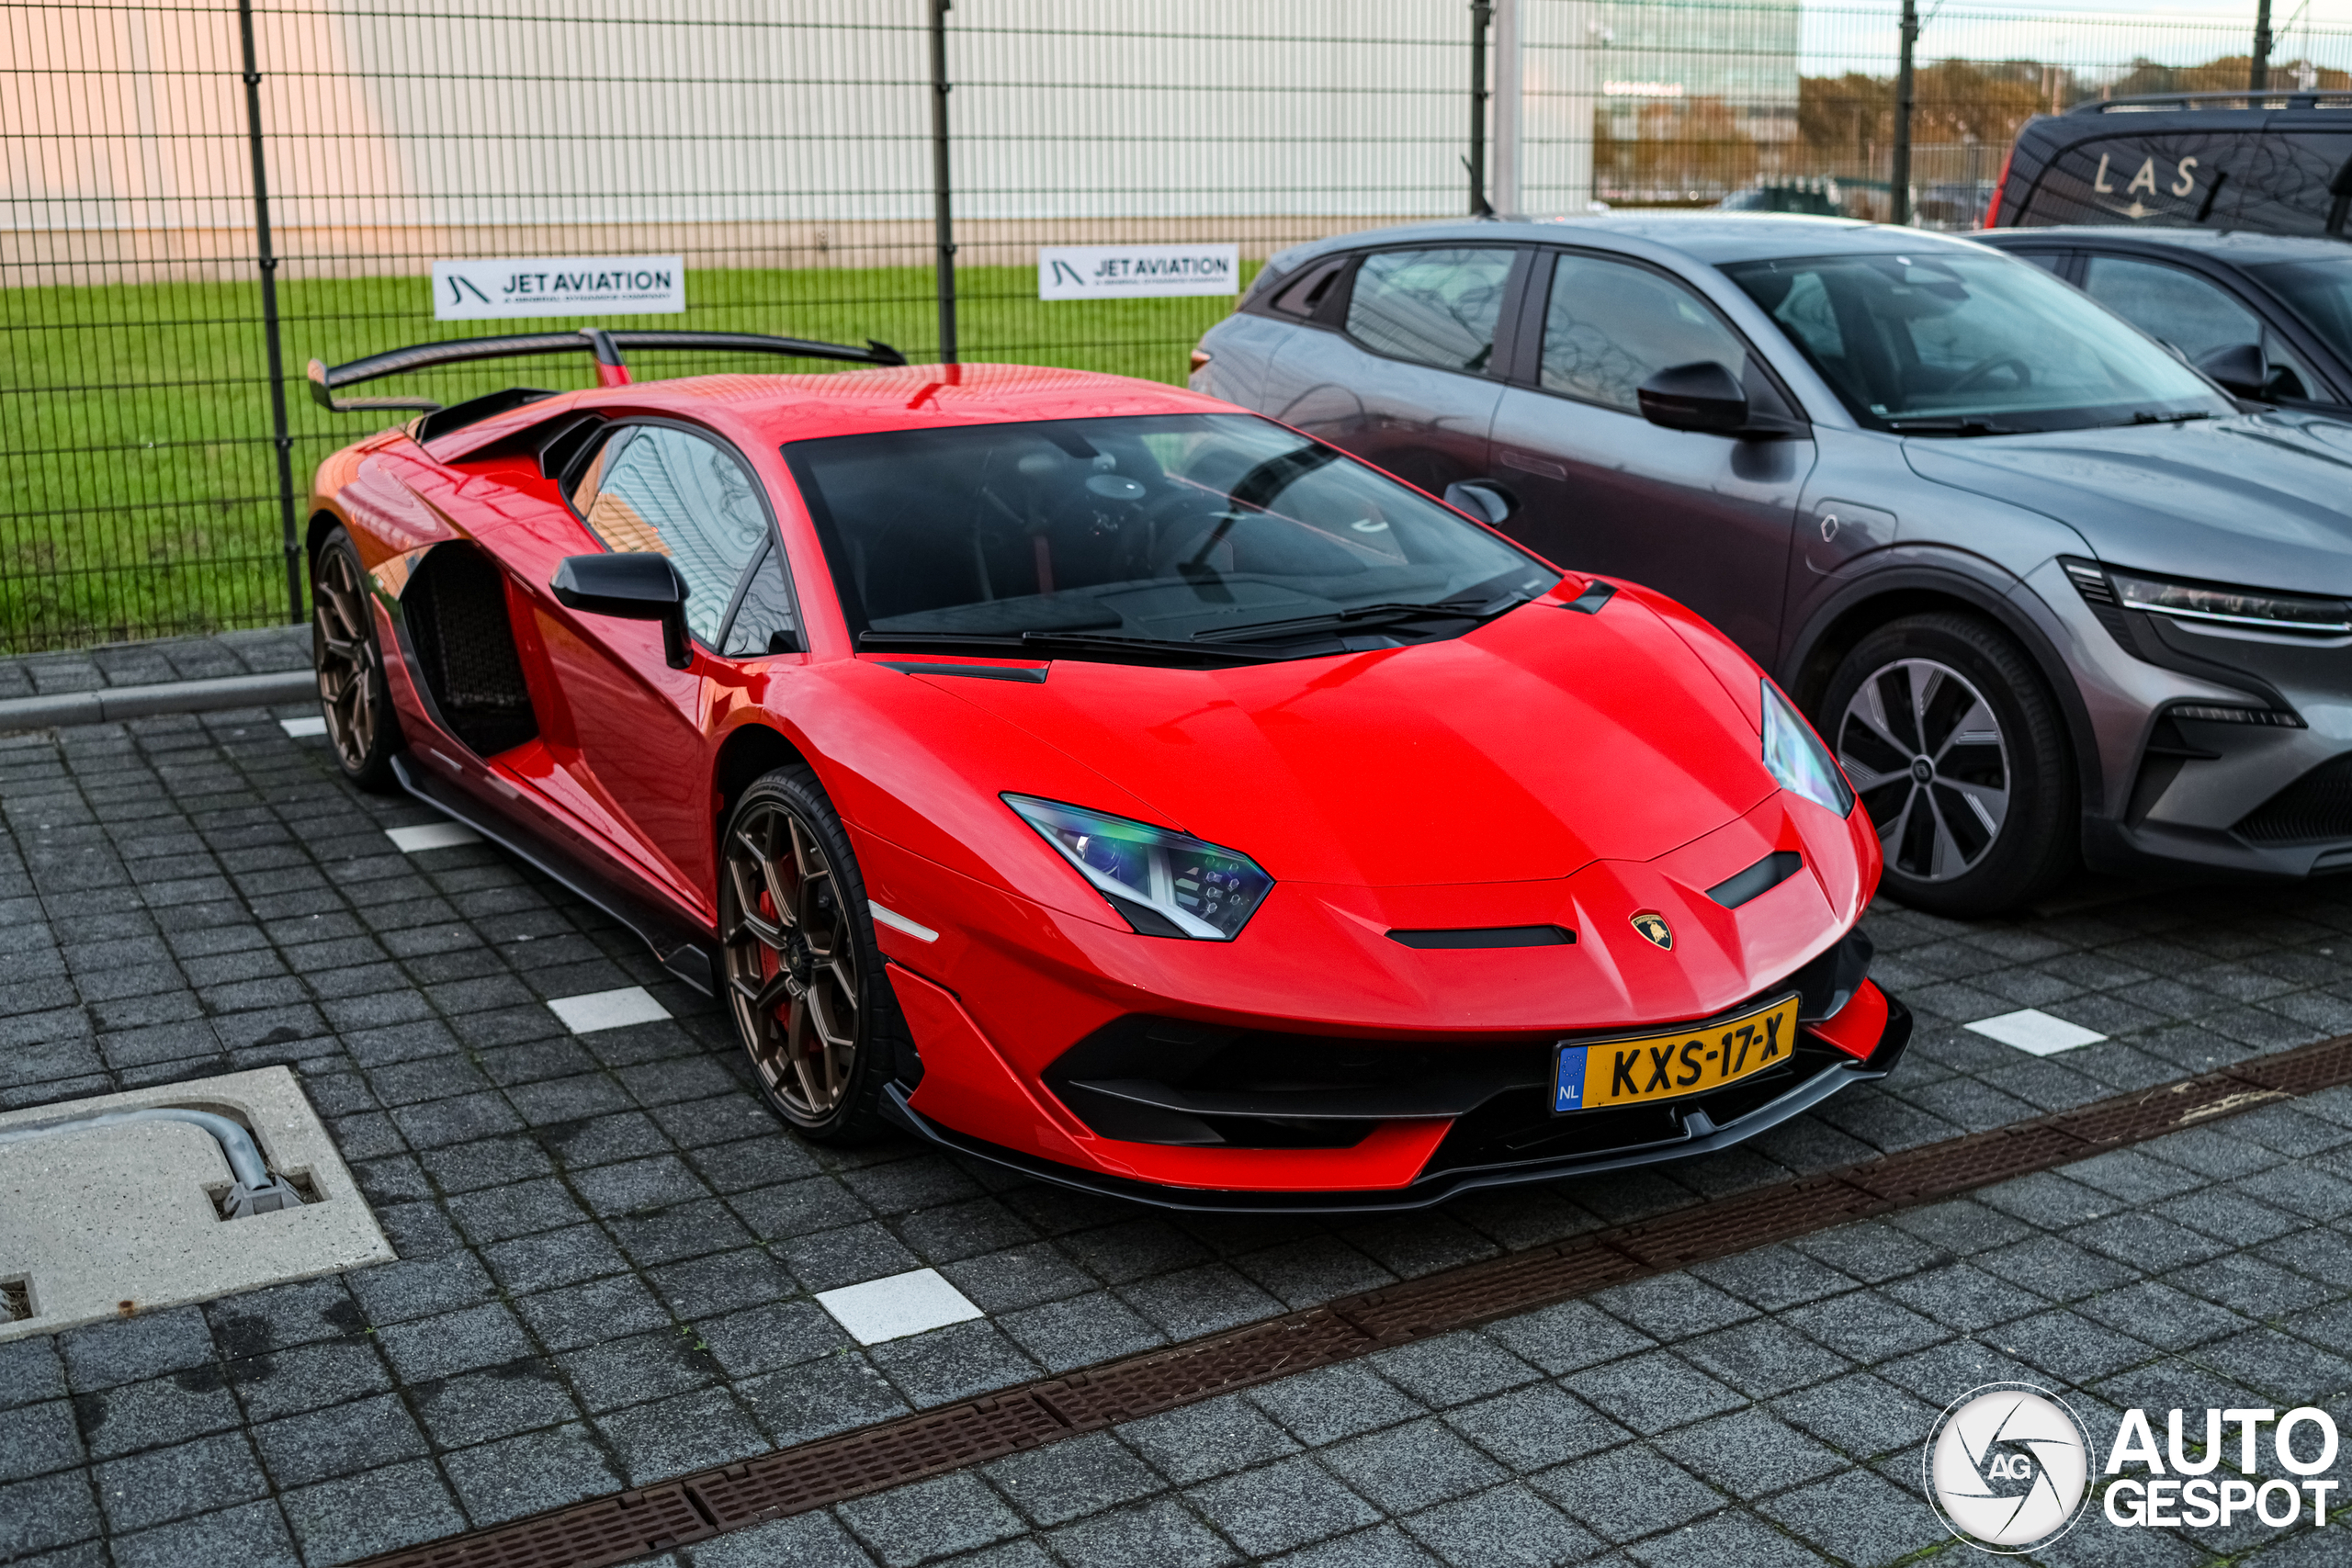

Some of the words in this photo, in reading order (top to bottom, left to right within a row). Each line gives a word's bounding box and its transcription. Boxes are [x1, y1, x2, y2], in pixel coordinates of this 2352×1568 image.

[2094, 152, 2199, 197] LAS
[503, 274, 548, 294] JET
[553, 271, 672, 292] AVIATION
[1093, 259, 1131, 277] JET
[1135, 258, 1229, 276] AVIATION
[1559, 1085, 1579, 1100] NL
[1611, 1012, 1784, 1097] KXS-17-X
